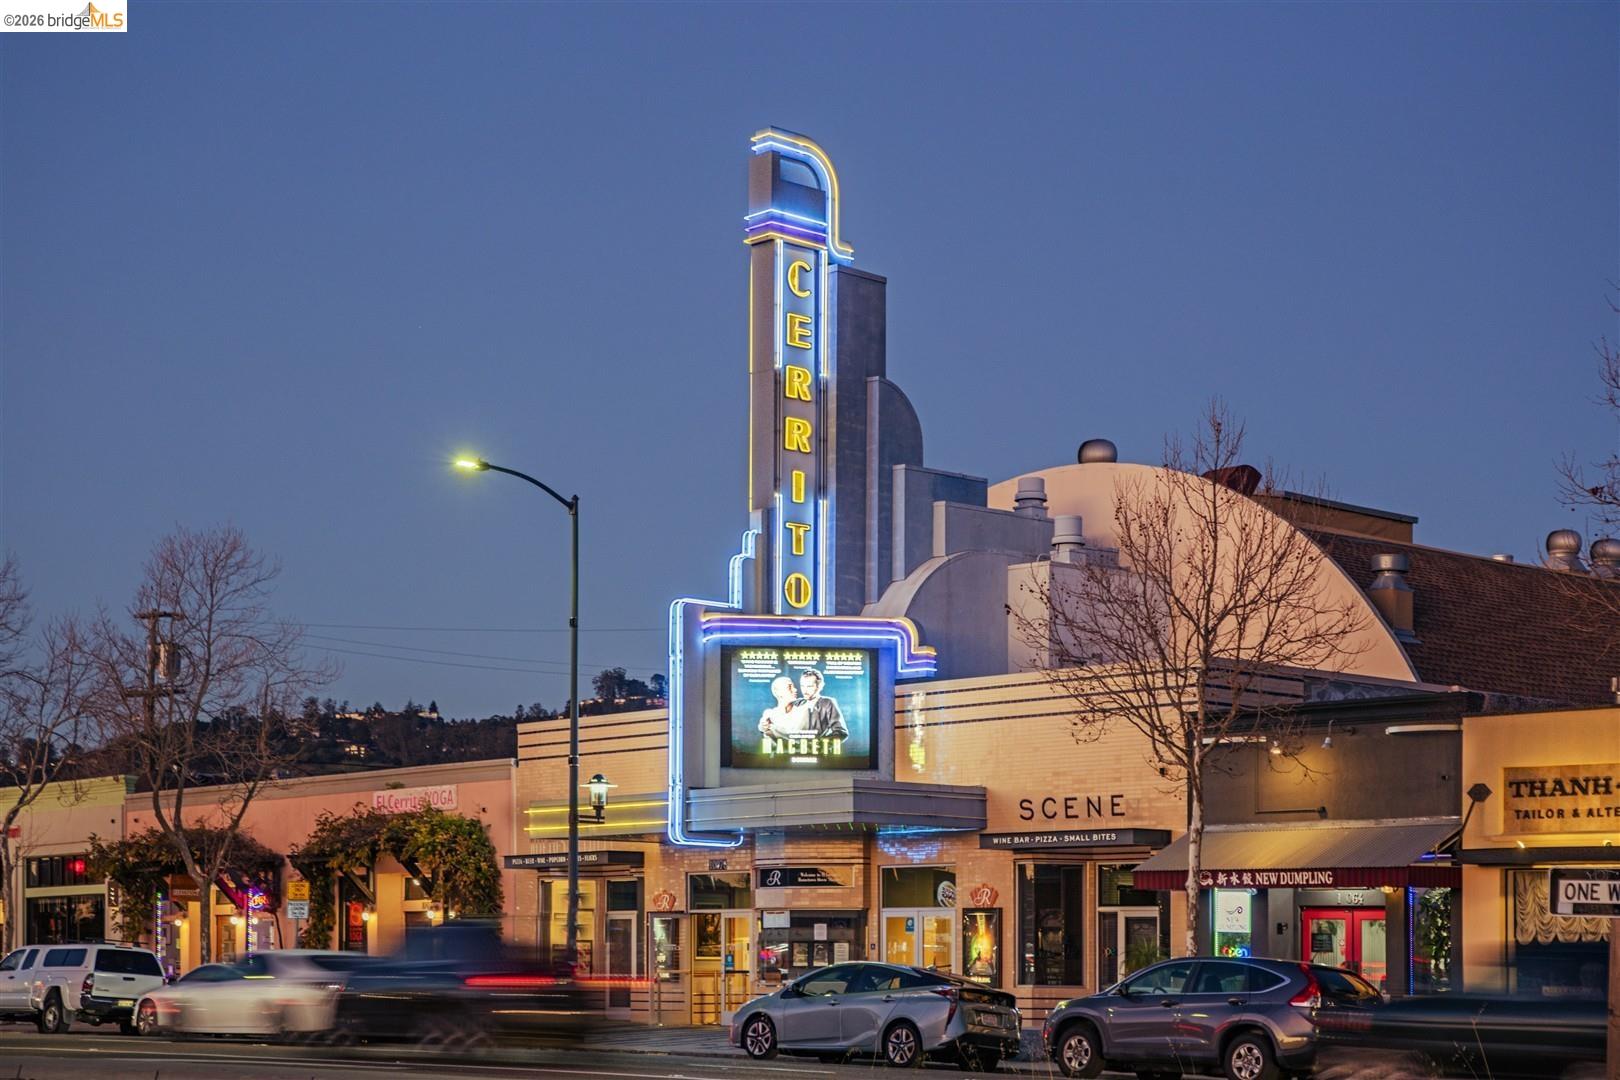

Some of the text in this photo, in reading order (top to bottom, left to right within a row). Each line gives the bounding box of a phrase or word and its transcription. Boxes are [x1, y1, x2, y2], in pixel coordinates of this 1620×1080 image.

[784, 260, 812, 608] CERRITO
[425, 789, 454, 805] YOGA
[1019, 794, 1125, 820] SCENE
[1514, 808, 1565, 820] TAILOR
[1572, 808, 1580, 818] &
[1014, 836, 1030, 844] BAR
[1035, 835, 1058, 843] PIZZA
[1064, 834, 1090, 842] SMALL
[1092, 833, 1117, 841] BITES
[1255, 871, 1334, 885] NEW DUMPLING
[1564, 882, 1601, 901] ONE
